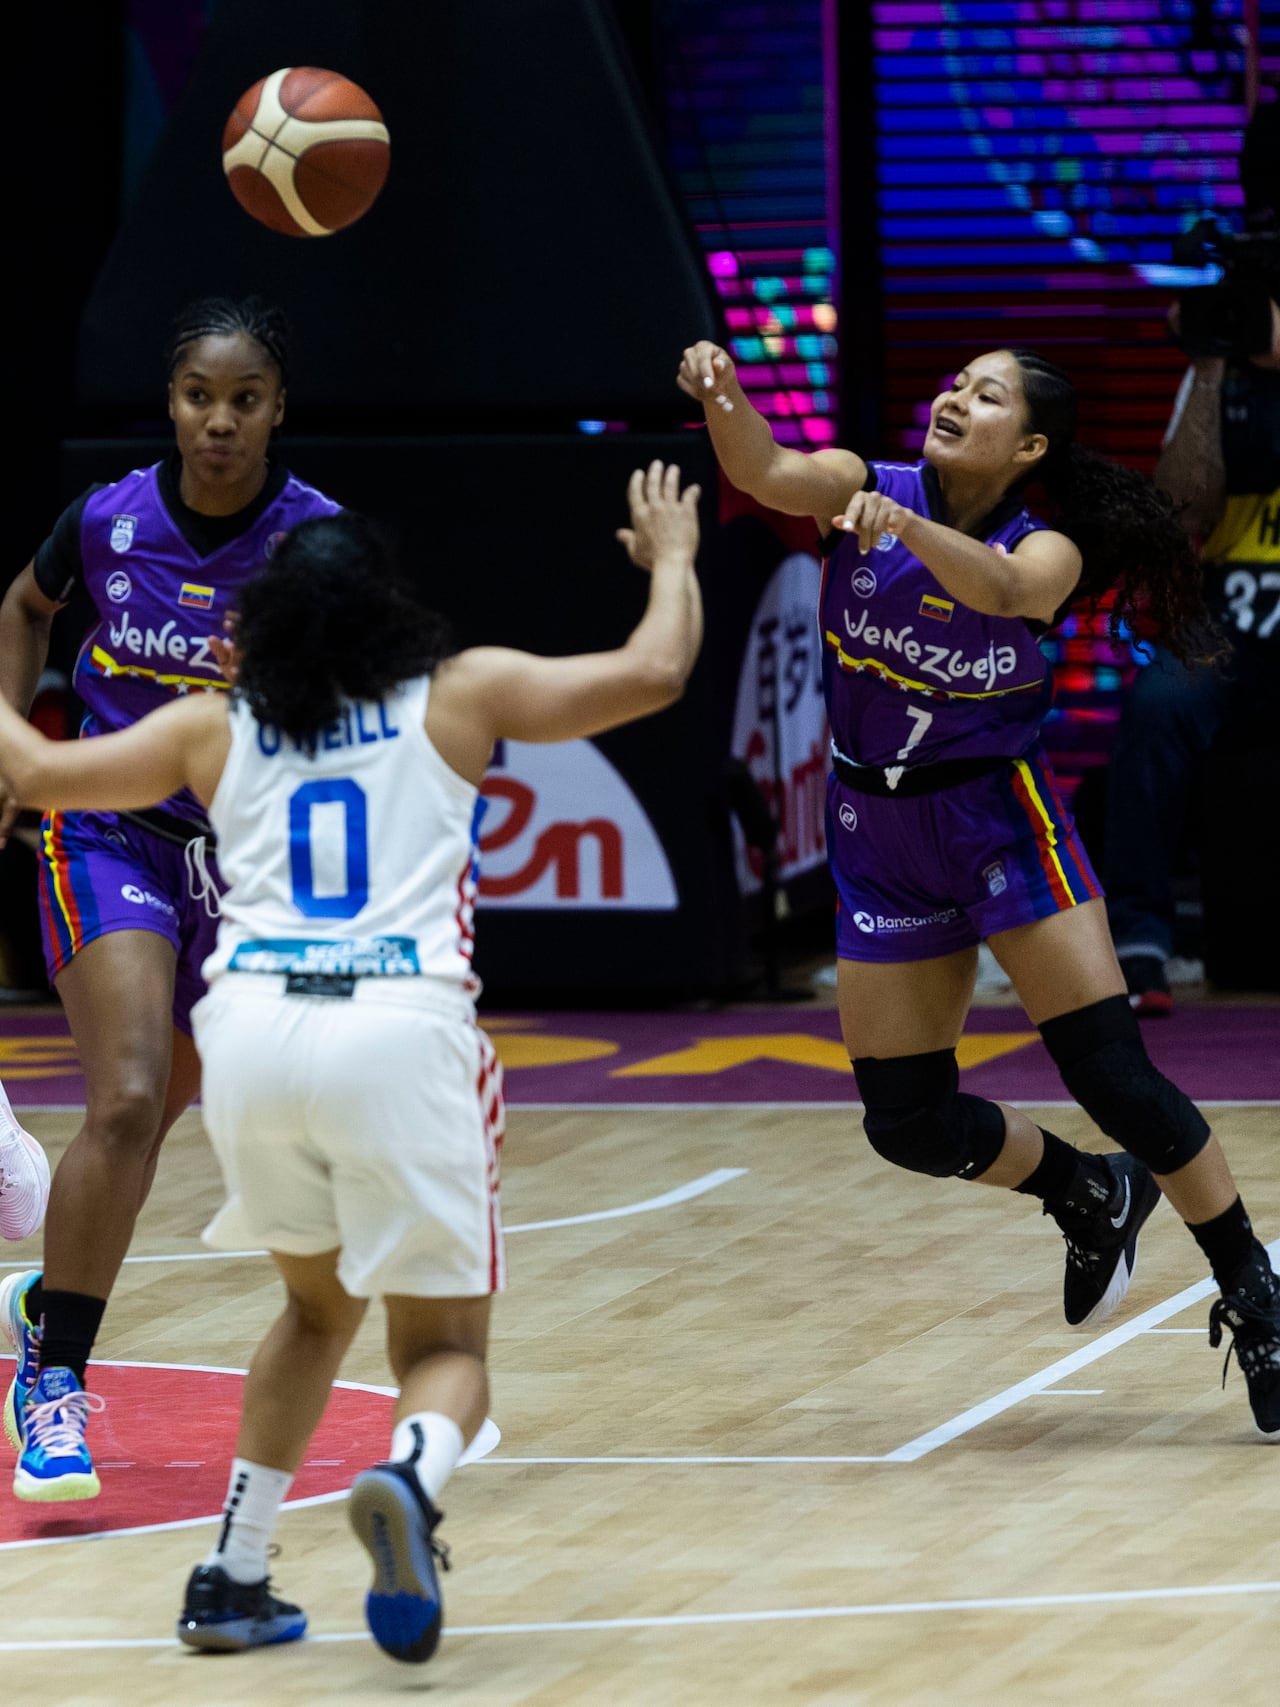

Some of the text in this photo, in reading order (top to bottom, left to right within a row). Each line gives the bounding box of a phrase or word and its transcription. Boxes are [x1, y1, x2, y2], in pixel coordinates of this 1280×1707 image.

[896, 704, 933, 760] 7
[288, 777, 369, 920] 0
[876, 907, 958, 930] Bancamiga
